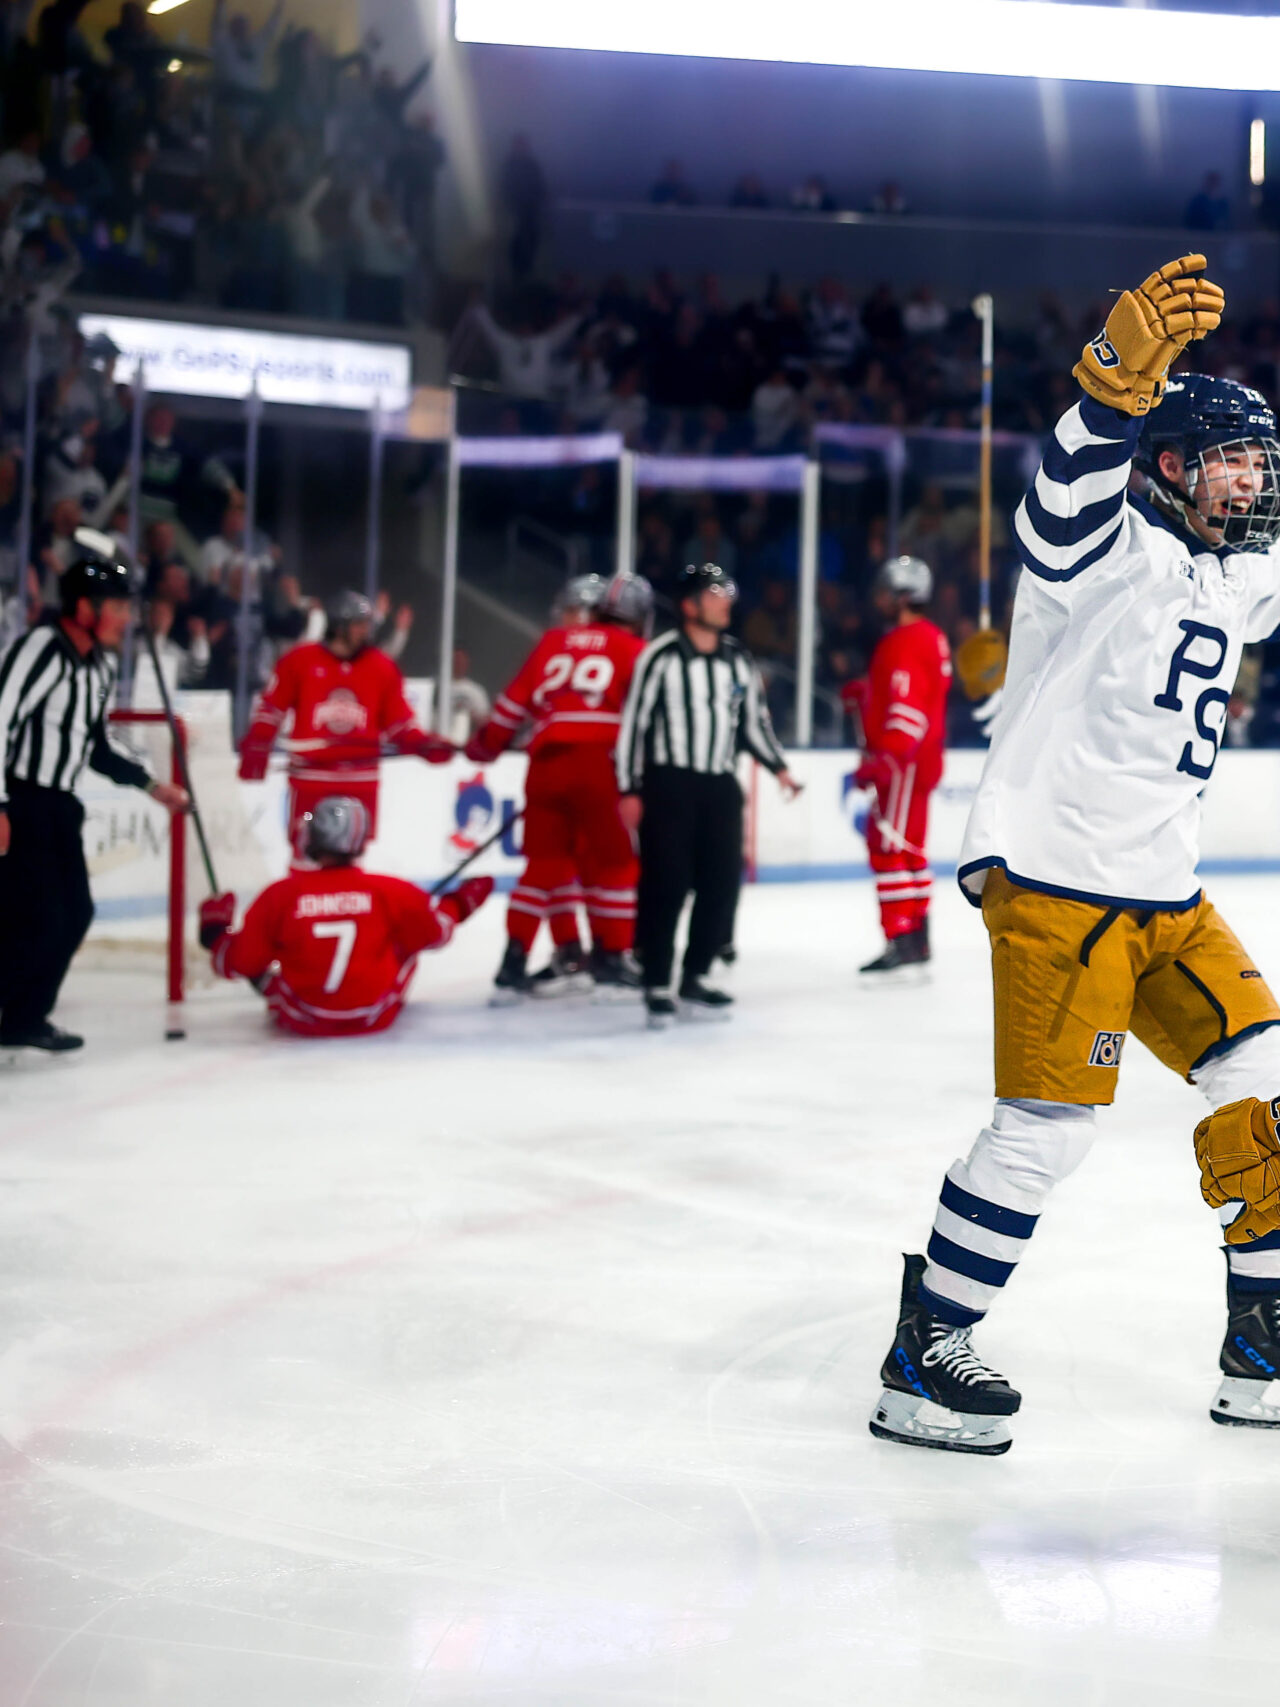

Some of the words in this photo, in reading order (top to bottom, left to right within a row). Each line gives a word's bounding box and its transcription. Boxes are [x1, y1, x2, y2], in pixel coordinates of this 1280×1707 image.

[532, 654, 616, 709] 29
[296, 892, 373, 919] JOHNSON
[312, 920, 357, 994] 7
[894, 1346, 932, 1400] CCM
[1234, 1335, 1276, 1374] CCM
